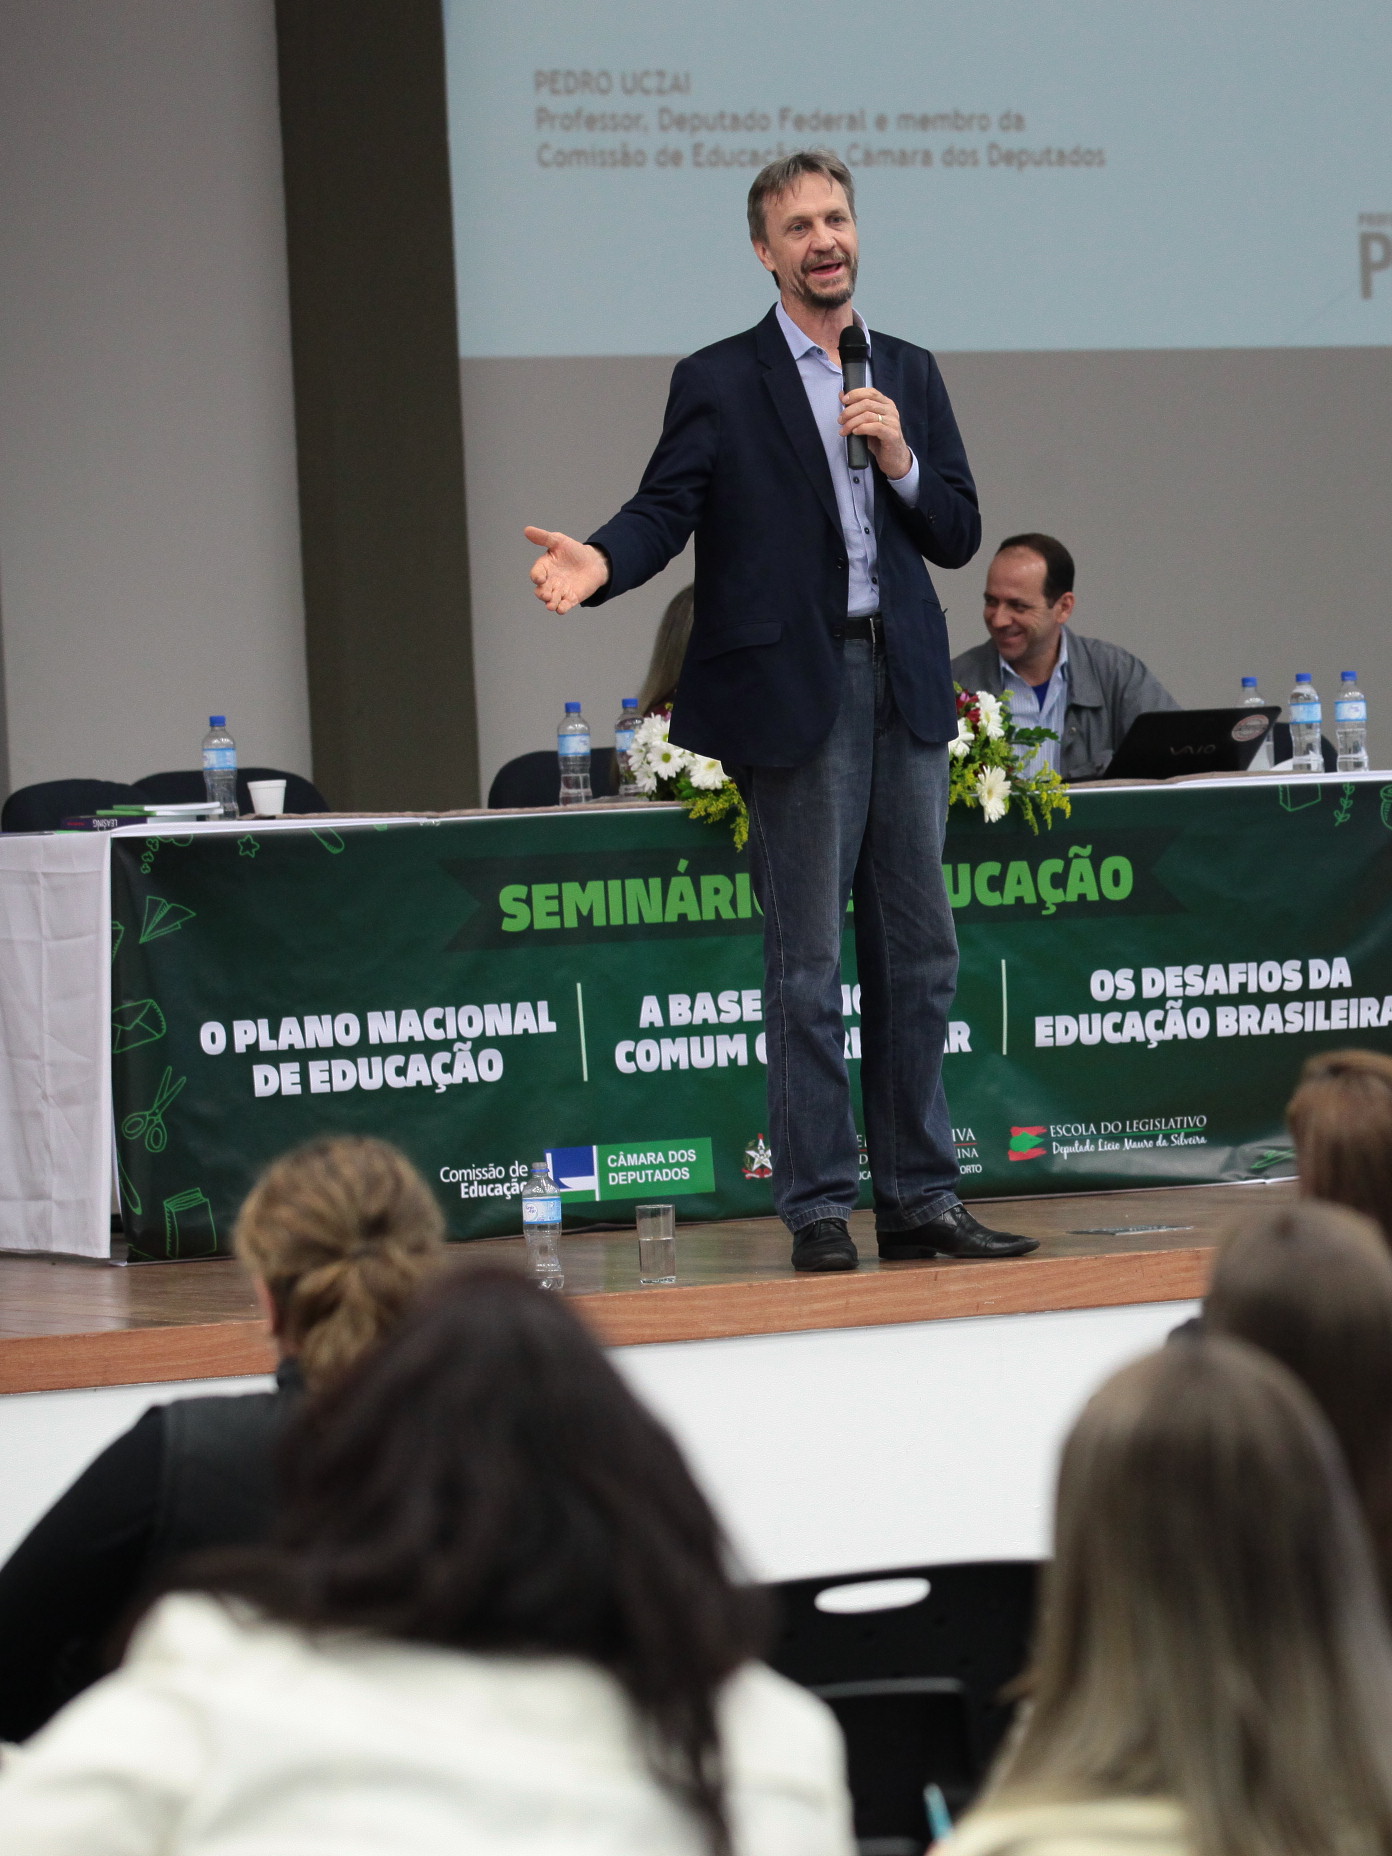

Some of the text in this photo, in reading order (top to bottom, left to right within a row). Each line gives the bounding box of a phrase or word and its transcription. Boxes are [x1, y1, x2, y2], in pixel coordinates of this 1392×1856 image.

[534, 69, 692, 95] PEDRO UCZAI
[536, 106, 1026, 136] Professor, Deputado Federal e membro da
[537, 142, 647, 168] Comissão
[656, 145, 685, 168] de
[845, 142, 934, 168] Câmara
[941, 144, 980, 168] dos
[987, 142, 1106, 172] Deputados
[92, 818, 118, 828] LEASING
[500, 858, 765, 932] SEMINÁRI
[1090, 957, 1352, 1001] OS DESAFIOS DA
[639, 989, 763, 1028] A BASE
[200, 1001, 557, 1055] O PLANO NACIONAL
[1035, 999, 1210, 1049] EDUCAÇÃO
[615, 1033, 748, 1074] COMUM
[253, 1041, 504, 1097] DE EDUCAÇÃO
[1050, 1115, 1207, 1137] ESCOLA DO LEGISLATIVO
[607, 1149, 696, 1168] CÂMARA DOS
[1052, 1139, 1095, 1160] Deputado
[1123, 1137, 1153, 1151] Mauro
[1155, 1134, 1168, 1147] da
[1171, 1131, 1208, 1146] Silveira
[440, 1160, 528, 1183] Comissão de
[608, 1167, 690, 1185] DEPUTADOS
